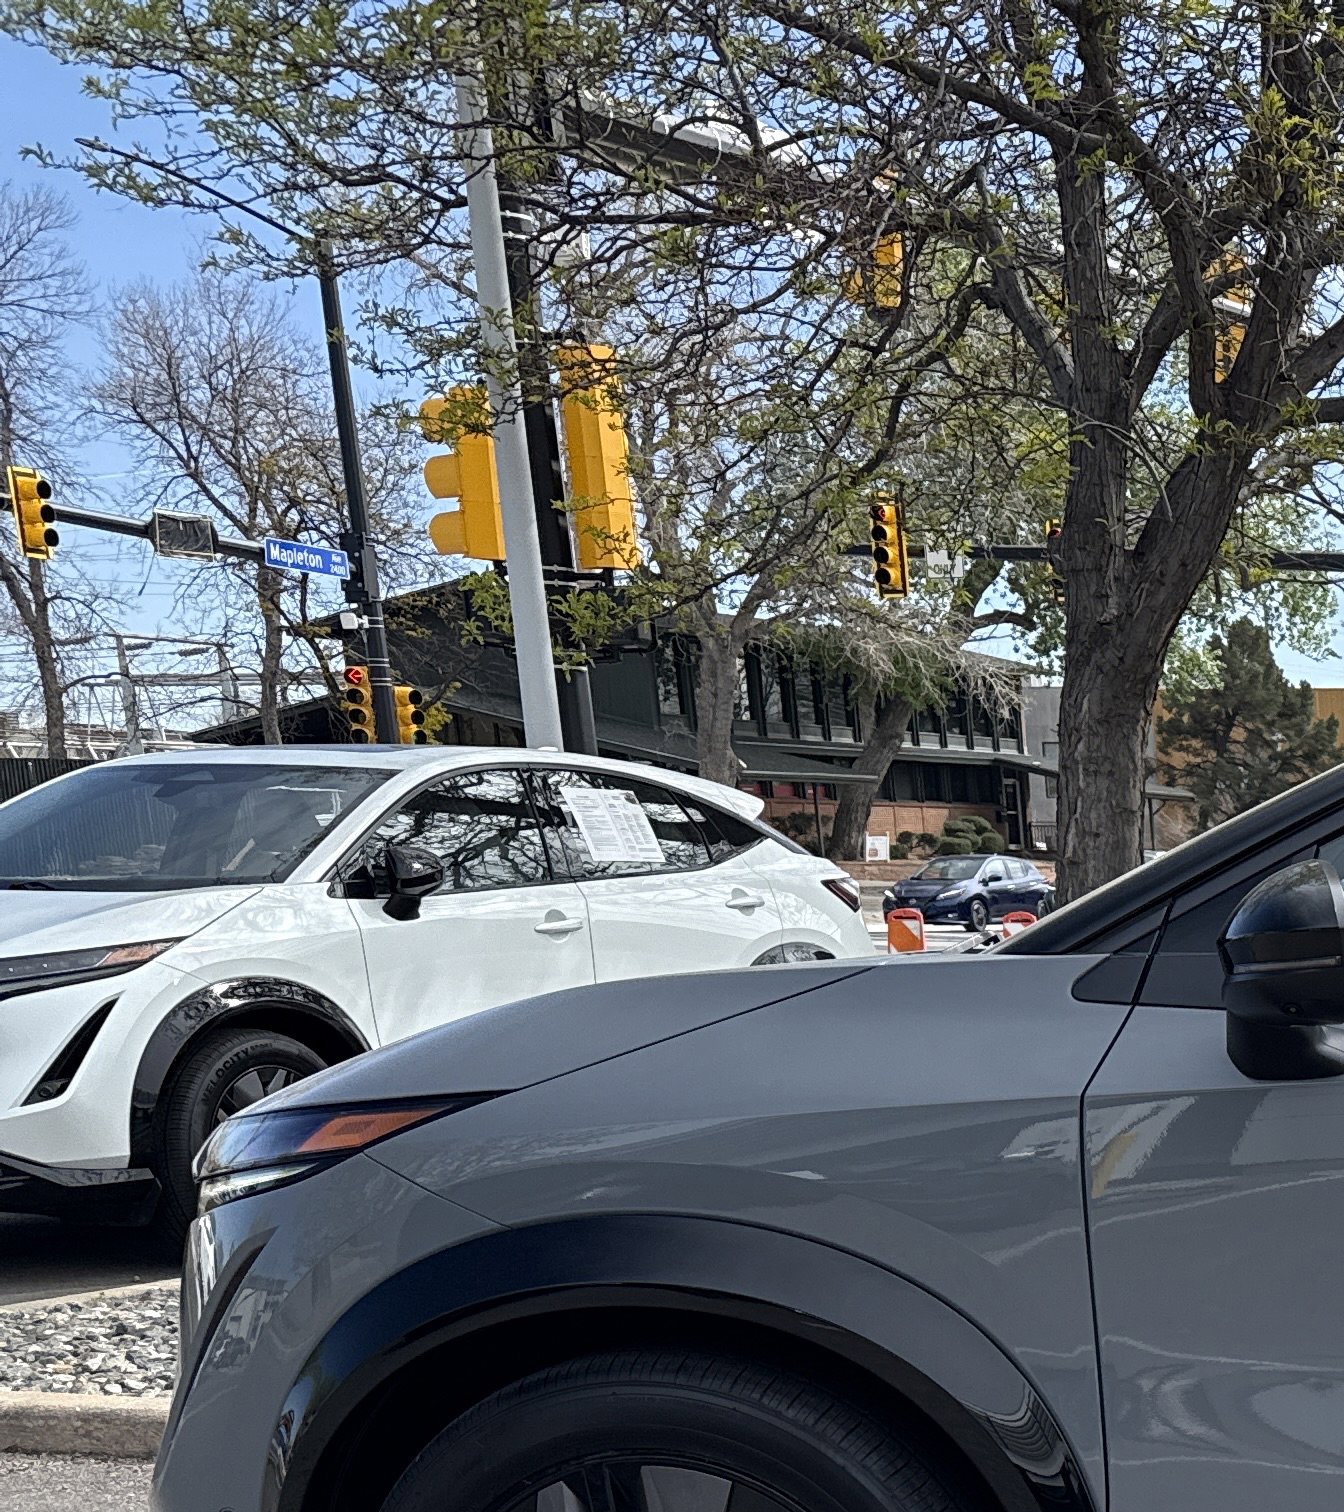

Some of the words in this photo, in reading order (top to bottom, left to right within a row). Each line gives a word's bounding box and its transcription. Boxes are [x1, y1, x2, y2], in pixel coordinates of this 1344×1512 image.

[269, 543, 323, 569] Mapleton
[329, 564, 346, 576] 2400
[201, 1047, 249, 1102] VELOCITY
